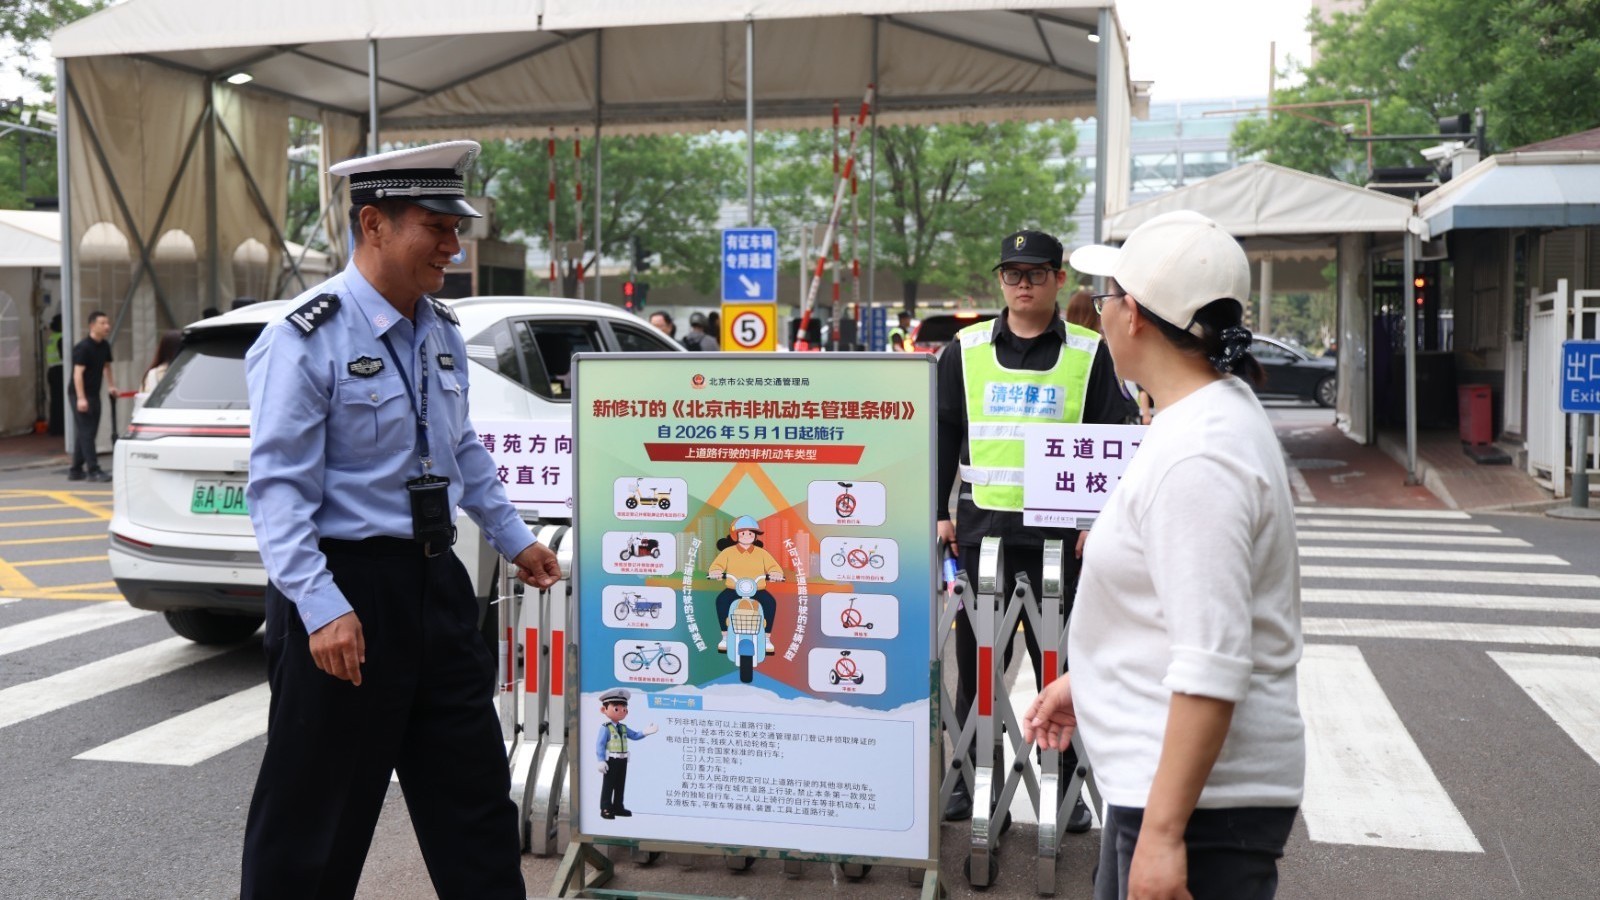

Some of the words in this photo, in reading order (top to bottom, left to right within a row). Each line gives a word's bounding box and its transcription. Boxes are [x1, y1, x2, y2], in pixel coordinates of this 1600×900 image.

[727, 234, 773, 250] 有证车辆
[1015, 236, 1024, 249] P
[726, 253, 772, 269] 专用通道
[741, 319, 756, 342] 5
[709, 377, 810, 387] 北京市公安局交通管理局
[991, 385, 1057, 405] 清华保卫
[1571, 389, 1600, 403] Exit
[593, 399, 915, 420] 新修订的《北京市非机动车管理条例》
[685, 447, 817, 461] 上道路行驶的非机动车类型
[1055, 471, 1121, 494] 出校
[682, 537, 708, 652] 可以上道路行驶的车辆类型
[783, 538, 808, 662] 不可以上道路行驶的车辆类型
